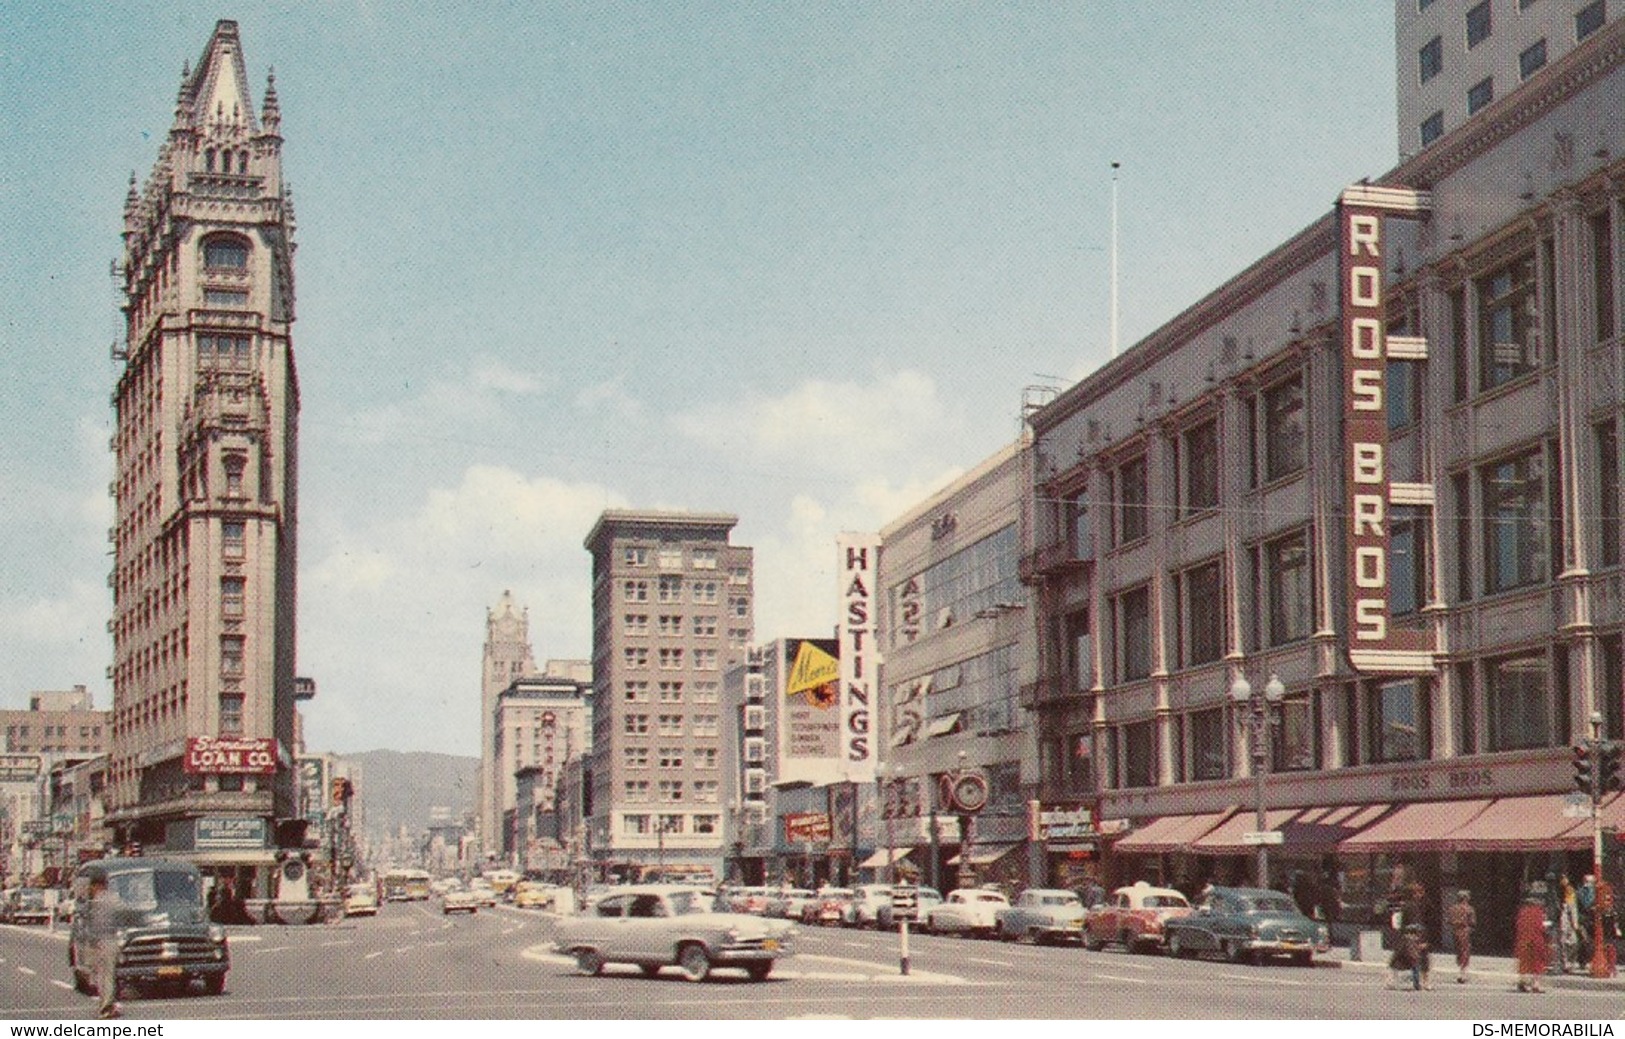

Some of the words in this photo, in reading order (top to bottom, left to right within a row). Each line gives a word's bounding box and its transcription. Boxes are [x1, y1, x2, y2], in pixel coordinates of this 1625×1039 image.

[1350, 215, 1382, 410] ROOS
[1353, 442, 1386, 640] BROS
[846, 546, 869, 762] HASTINGS
[191, 751, 241, 766] LOAN
[248, 751, 275, 766] CO.
[1391, 774, 1430, 791] ROOS
[1449, 769, 1492, 787] BROS
